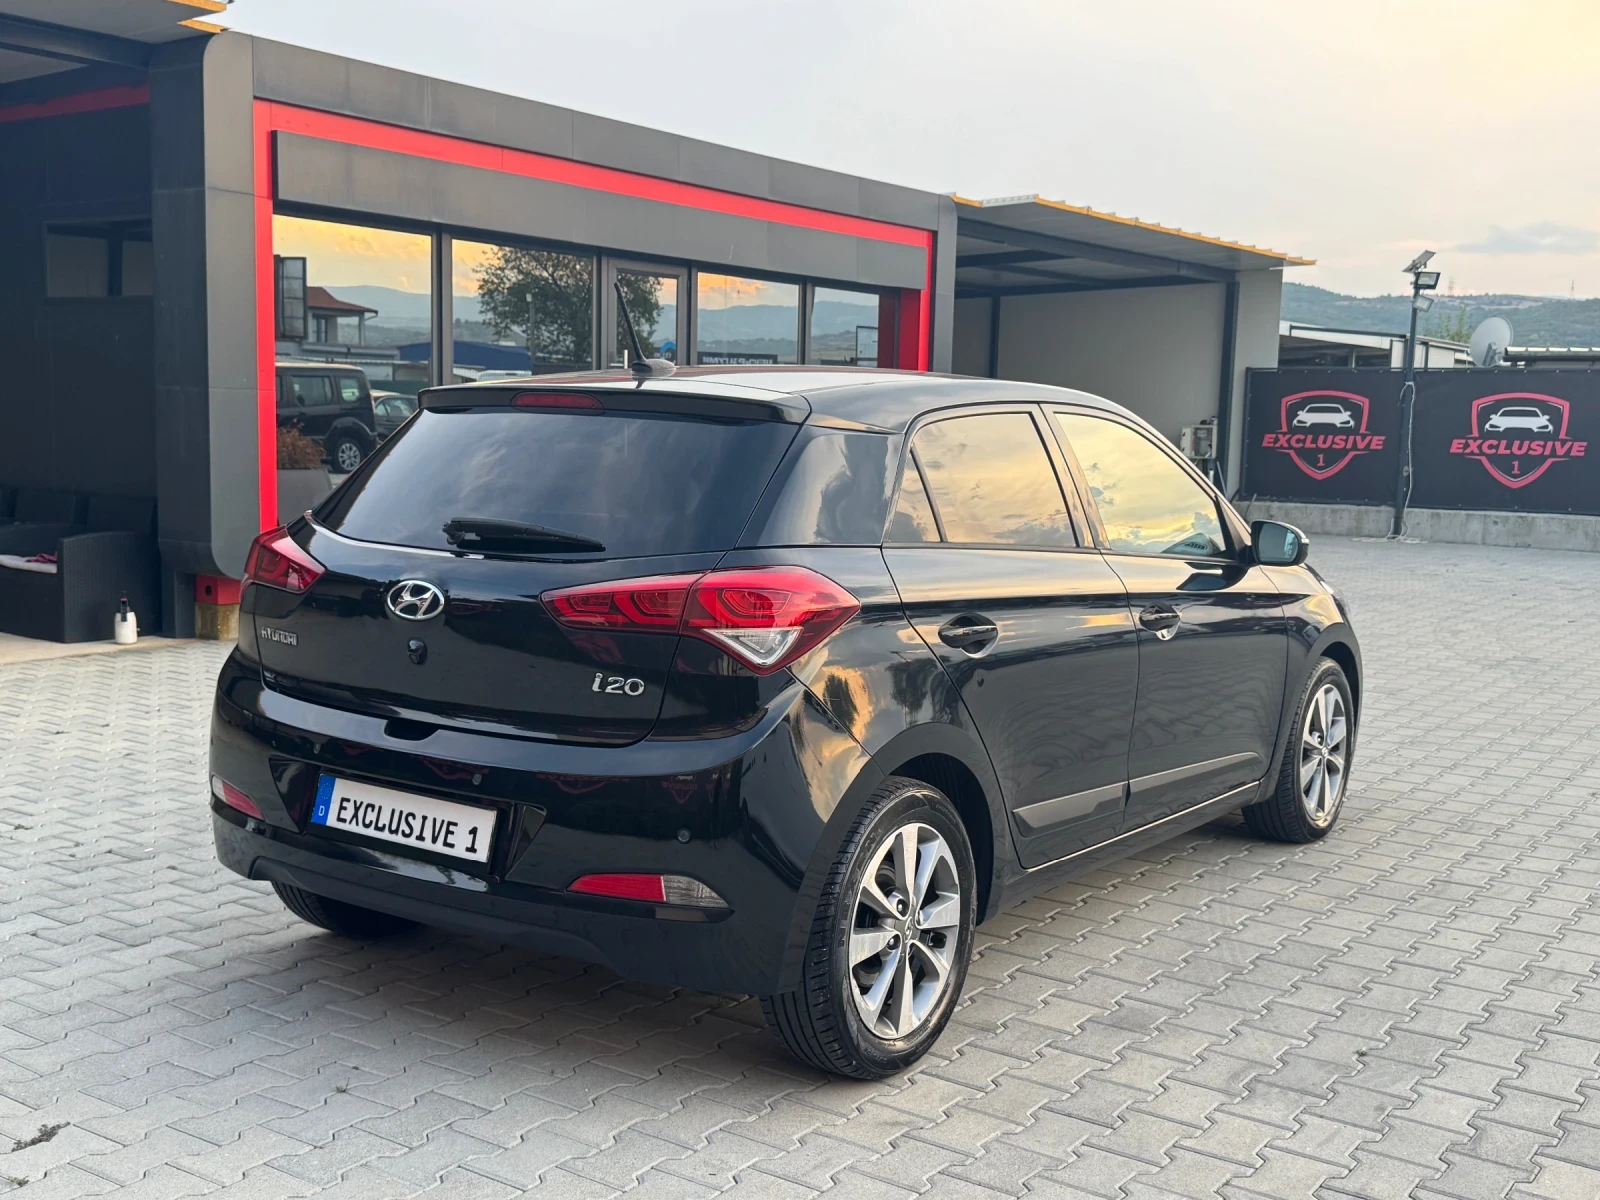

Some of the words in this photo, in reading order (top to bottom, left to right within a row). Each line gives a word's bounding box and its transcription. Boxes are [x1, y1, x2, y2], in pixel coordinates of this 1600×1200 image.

[1261, 434, 1386, 449] EXCLUSIVE
[1449, 439, 1588, 456] EXCLUSIVE
[1316, 454, 1325, 467] 1
[1511, 461, 1520, 474] 1
[261, 627, 297, 646] HYUNDAI
[592, 672, 645, 696] i20
[318, 806, 325, 816] D
[336, 797, 458, 848] EXCLUSIVE
[465, 826, 479, 853] 1
